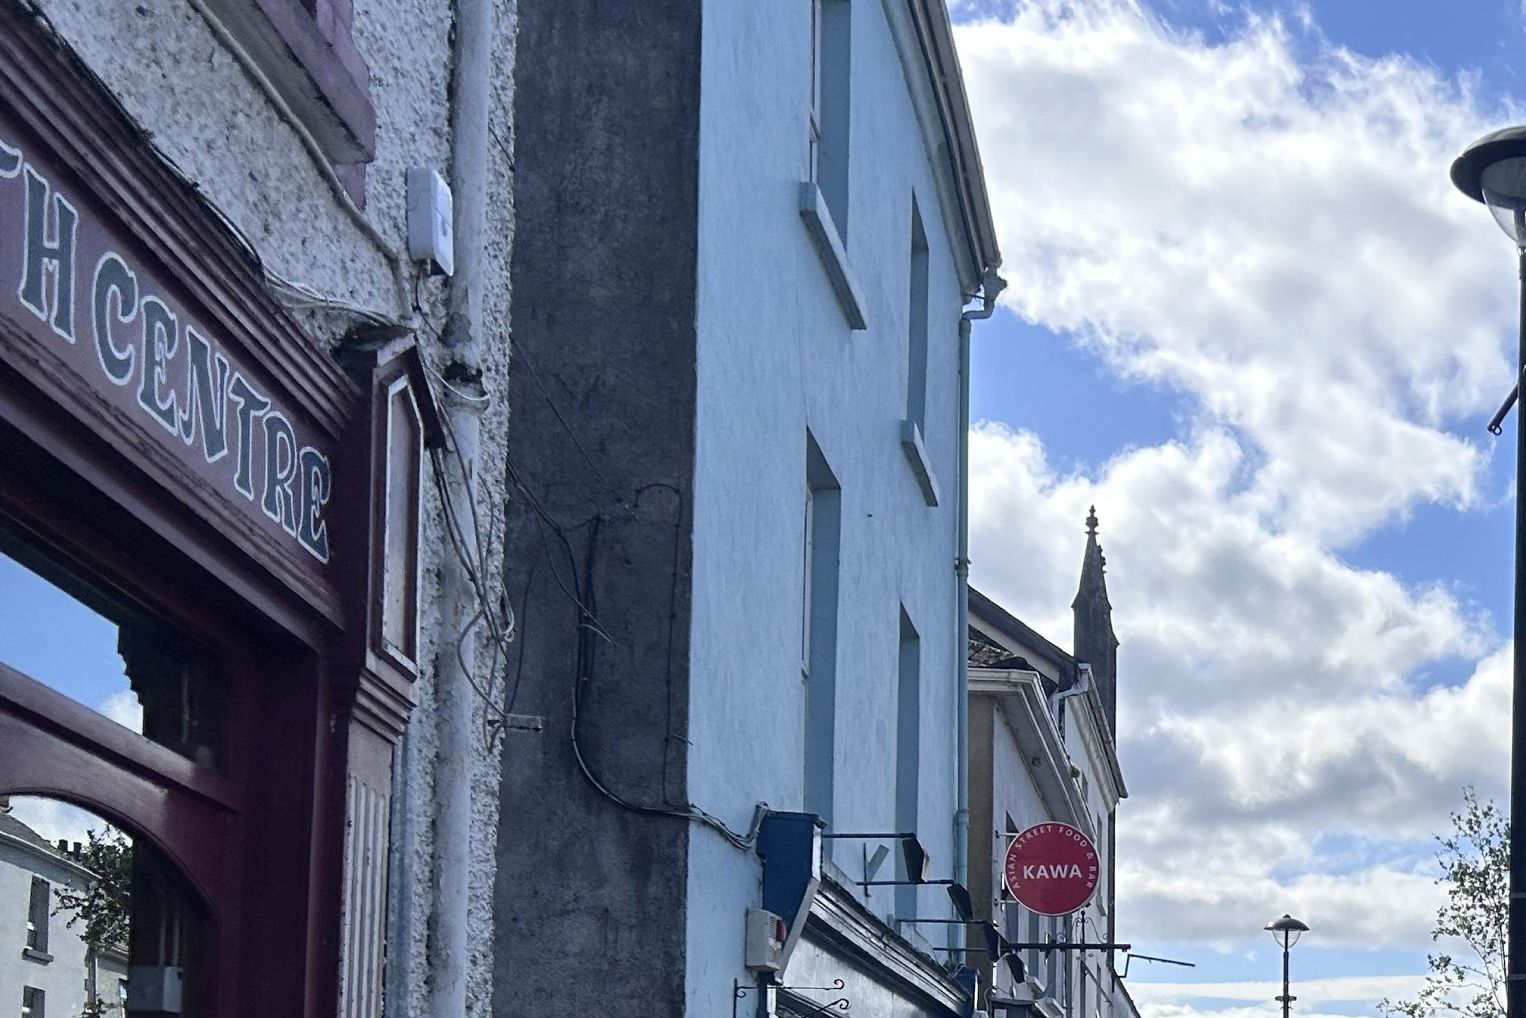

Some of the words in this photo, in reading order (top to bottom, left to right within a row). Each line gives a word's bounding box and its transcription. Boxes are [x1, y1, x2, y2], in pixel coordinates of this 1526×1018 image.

[0, 144, 78, 344] H
[92, 251, 332, 564] CENTRE
[1015, 825, 1053, 849] STREET
[1059, 826, 1088, 847] FOOD
[1086, 852, 1095, 860] &
[1008, 854, 1020, 889] ASIAN
[1023, 864, 1082, 879] KAWA
[1086, 866, 1097, 888] BAR
